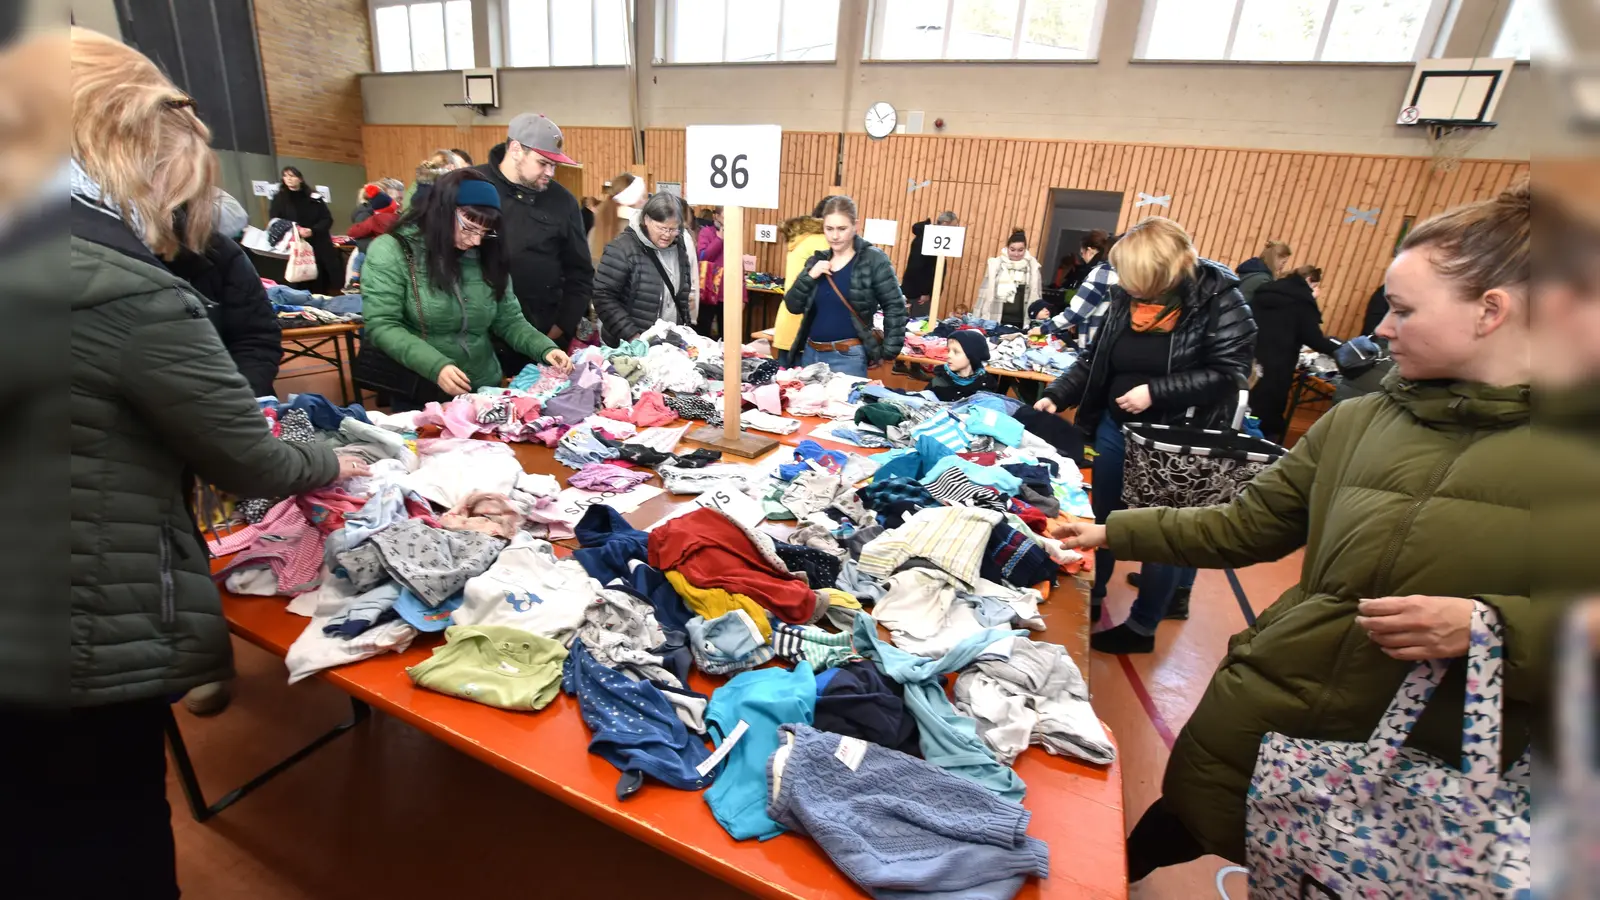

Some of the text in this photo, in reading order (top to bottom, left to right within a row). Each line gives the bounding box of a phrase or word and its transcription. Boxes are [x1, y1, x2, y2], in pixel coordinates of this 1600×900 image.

[710, 154, 749, 189] 86
[760, 230, 771, 239] 98
[933, 235, 951, 250] 92
[564, 488, 636, 515] odys
